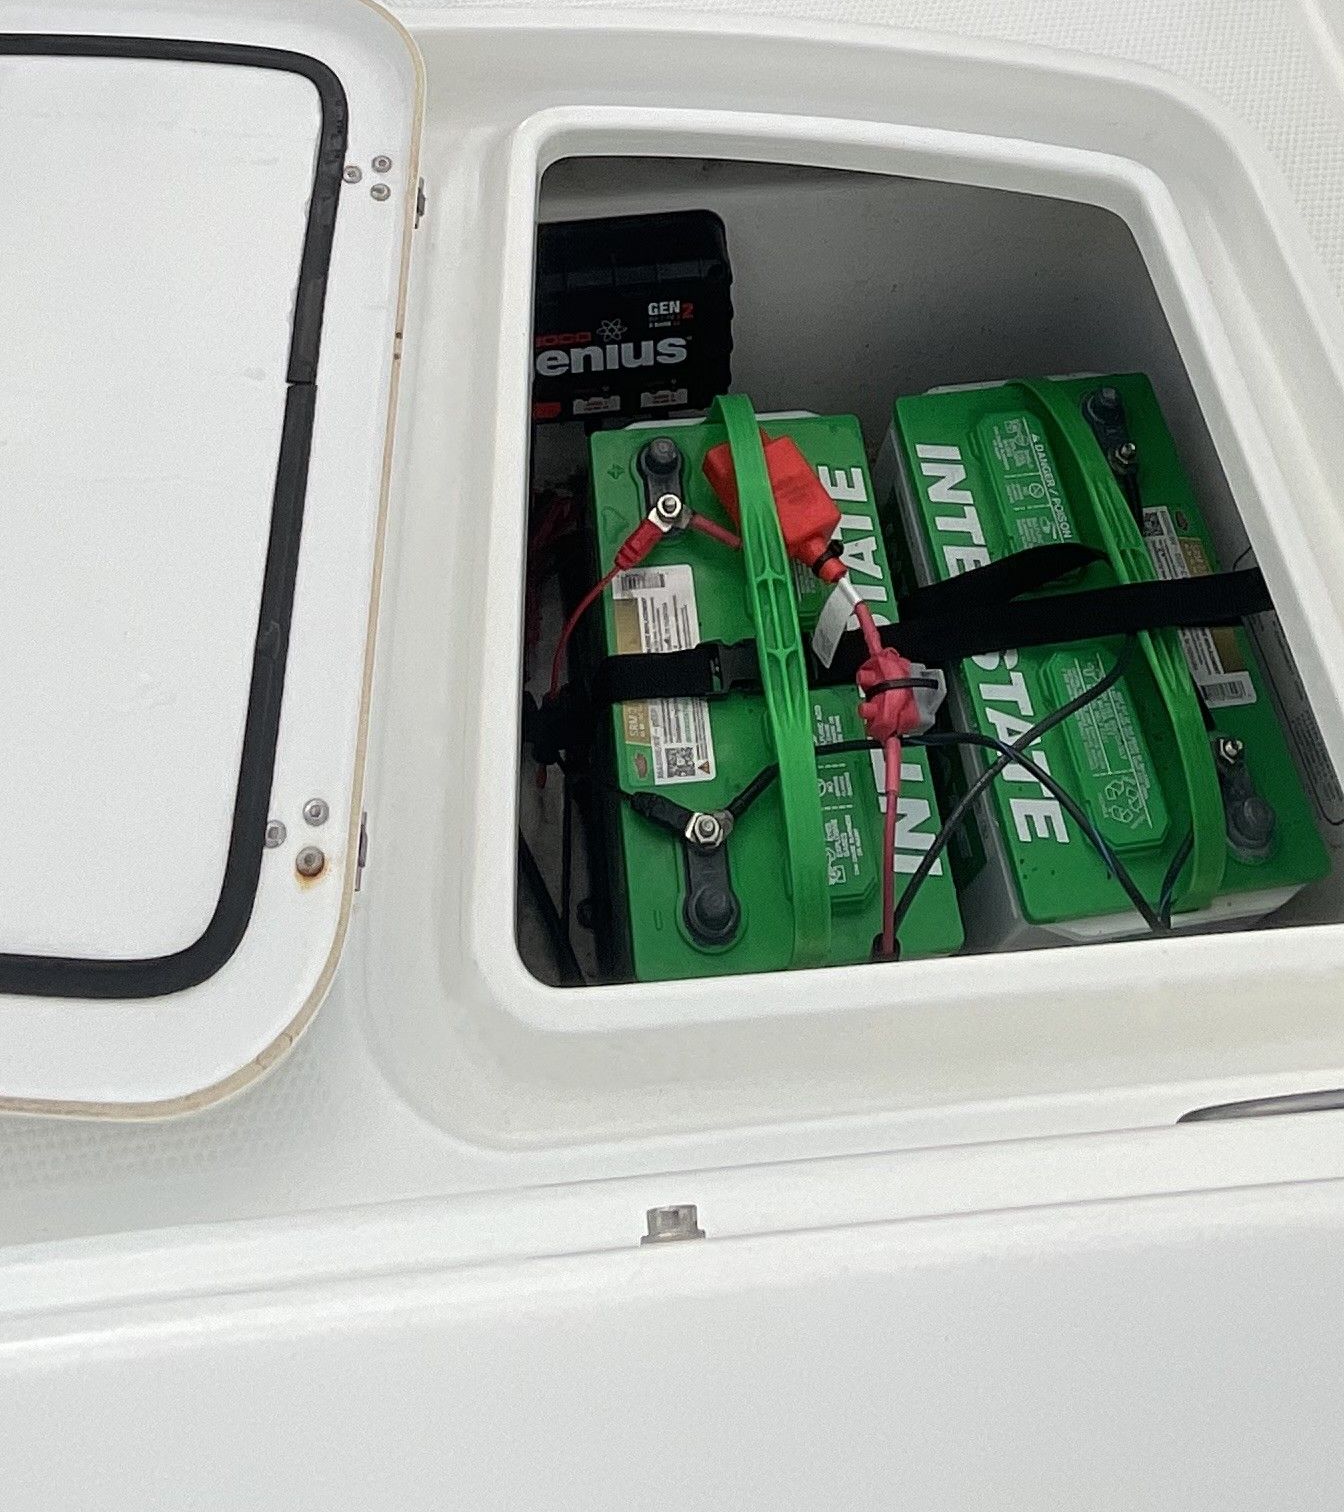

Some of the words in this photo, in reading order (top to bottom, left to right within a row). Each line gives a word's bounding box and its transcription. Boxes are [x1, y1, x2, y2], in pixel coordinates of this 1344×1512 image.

[536, 337, 688, 376] enius
[1034, 444, 1057, 488] DANGER
[1051, 498, 1072, 539] POISON
